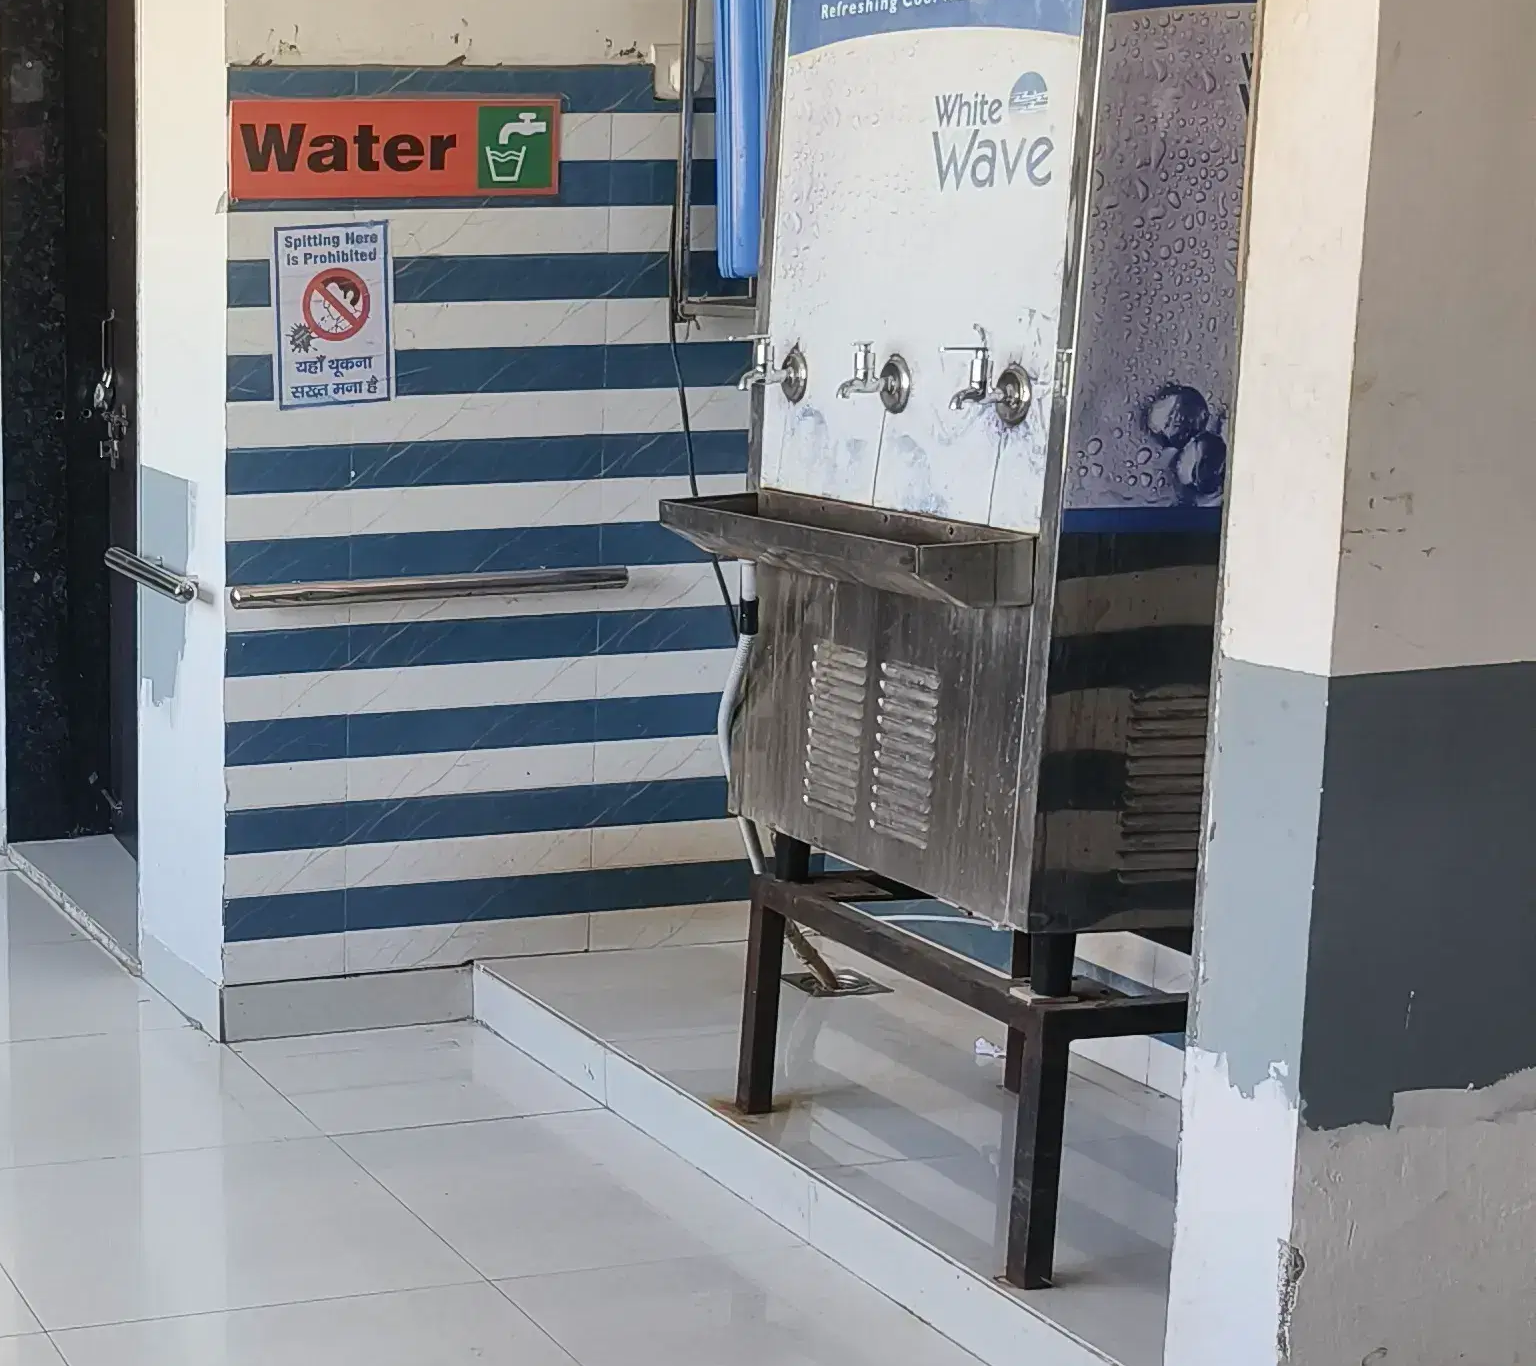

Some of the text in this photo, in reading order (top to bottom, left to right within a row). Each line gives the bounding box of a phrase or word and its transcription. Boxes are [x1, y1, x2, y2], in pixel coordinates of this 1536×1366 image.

[935, 91, 1003, 128] White
[240, 123, 457, 172] Water
[932, 129, 1054, 193] Wave
[284, 232, 378, 250] Spitting Here
[303, 247, 377, 265] Prohibited
[295, 355, 373, 378] यहाँ थूकना
[332, 381, 363, 395] मना
[365, 375, 379, 393] है
